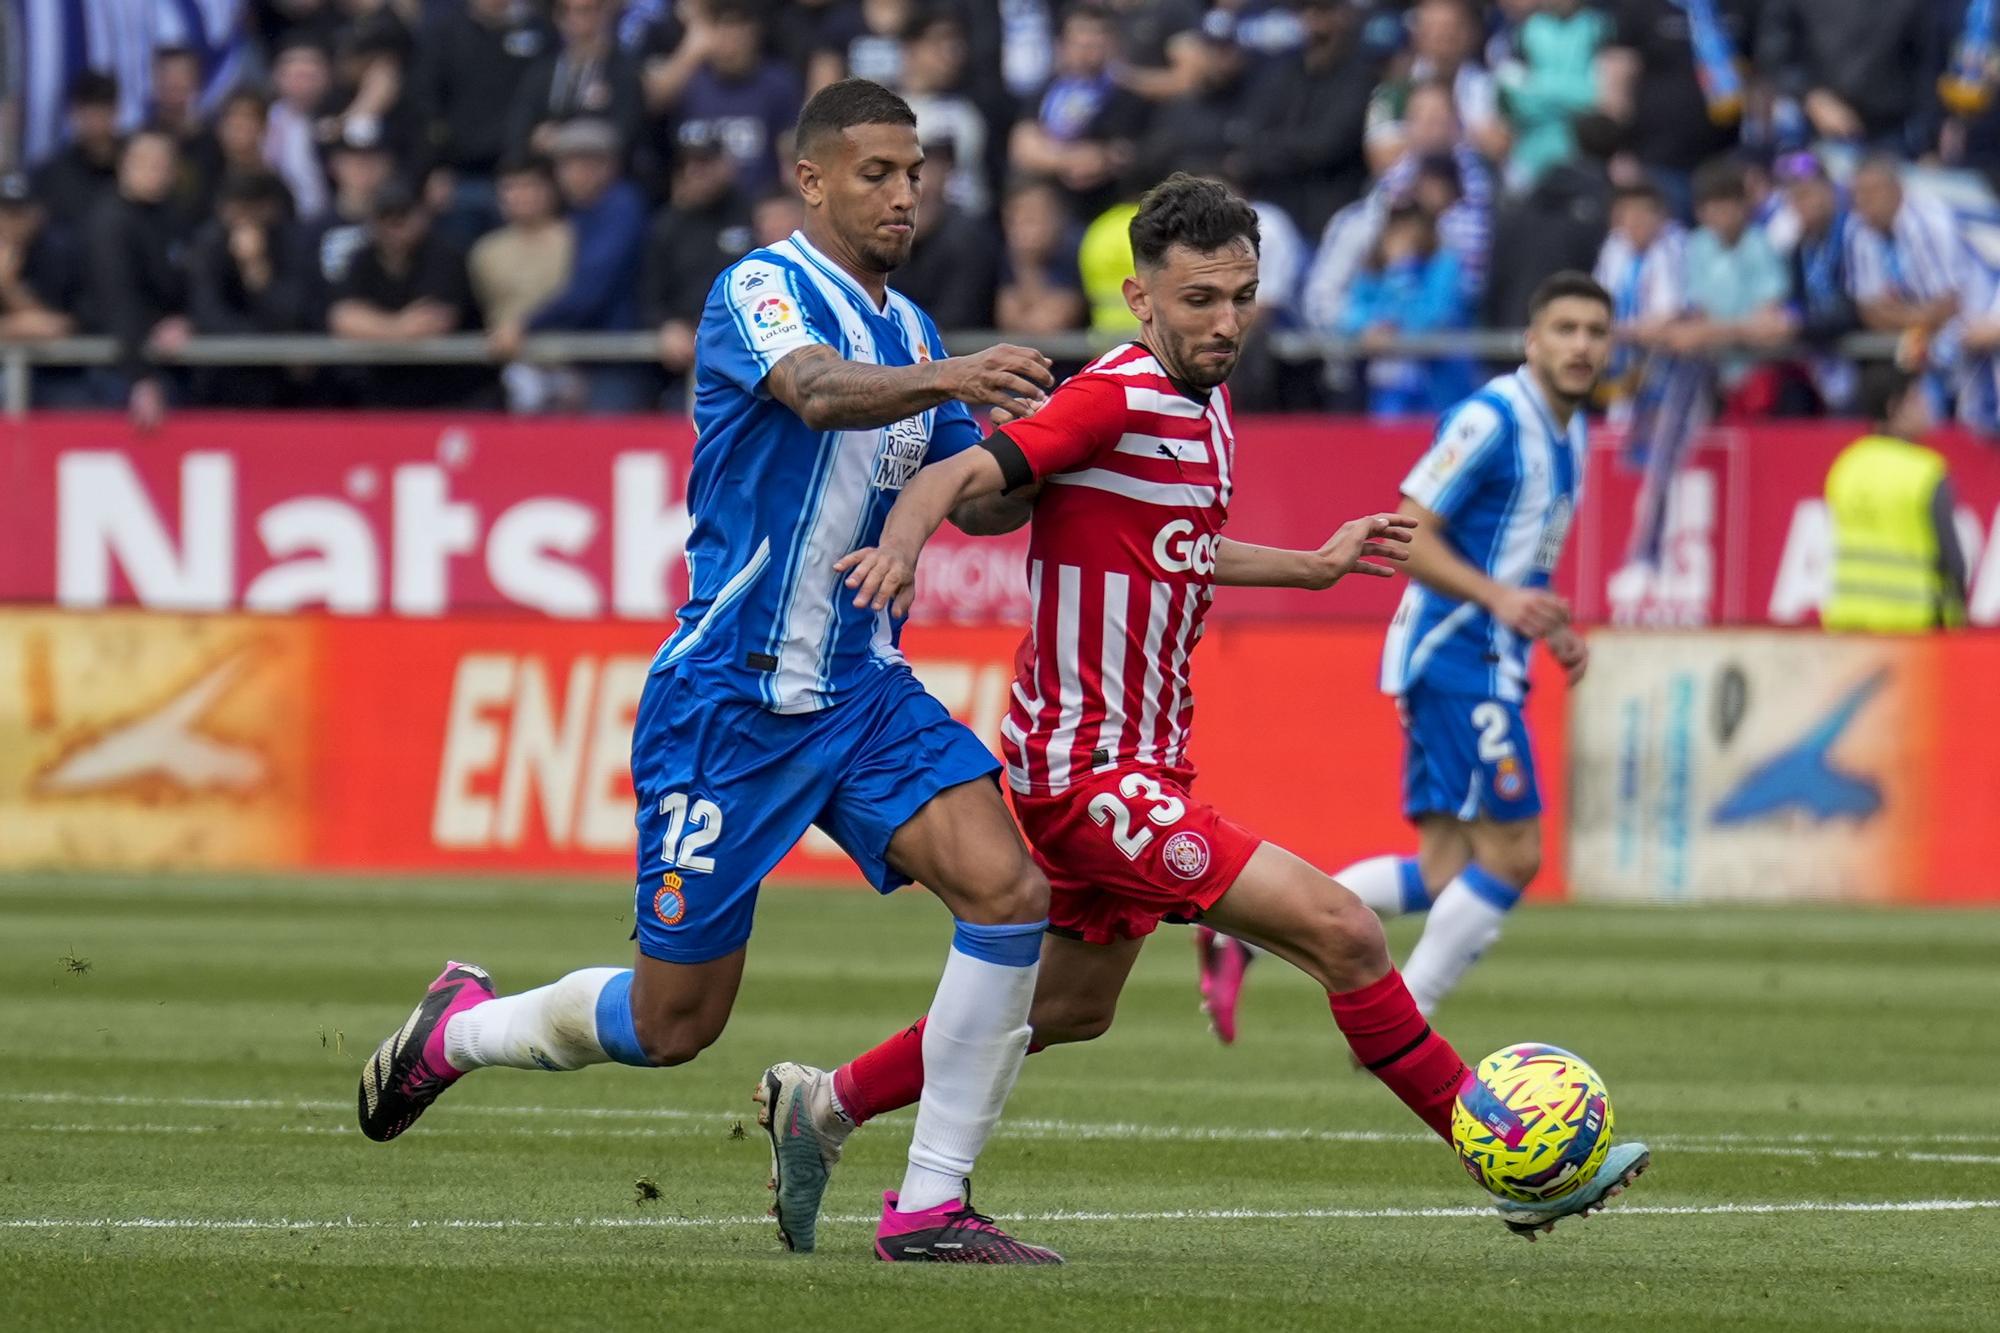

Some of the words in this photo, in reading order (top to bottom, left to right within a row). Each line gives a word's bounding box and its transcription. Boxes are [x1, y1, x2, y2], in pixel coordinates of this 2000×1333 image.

[760, 324, 798, 342] LaLiga
[1471, 701, 1516, 763] 2
[660, 792, 722, 873] 12
[1088, 772, 1185, 860] 23
